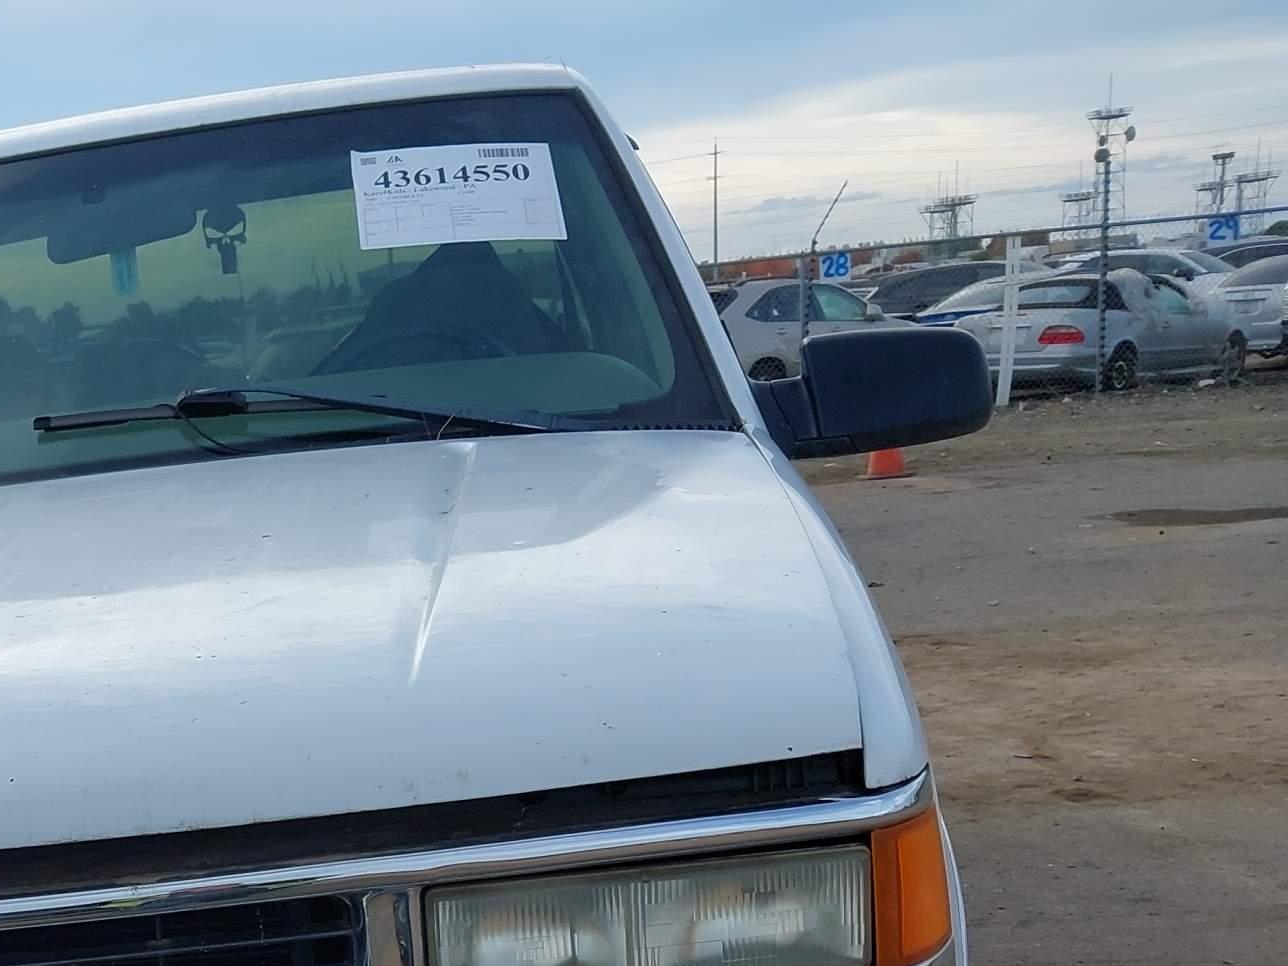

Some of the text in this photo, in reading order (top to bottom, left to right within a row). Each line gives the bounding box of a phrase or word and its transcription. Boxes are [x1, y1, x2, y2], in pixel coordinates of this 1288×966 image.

[373, 163, 530, 188] 43614550
[1209, 215, 1239, 241] 29
[822, 252, 849, 278] 28
